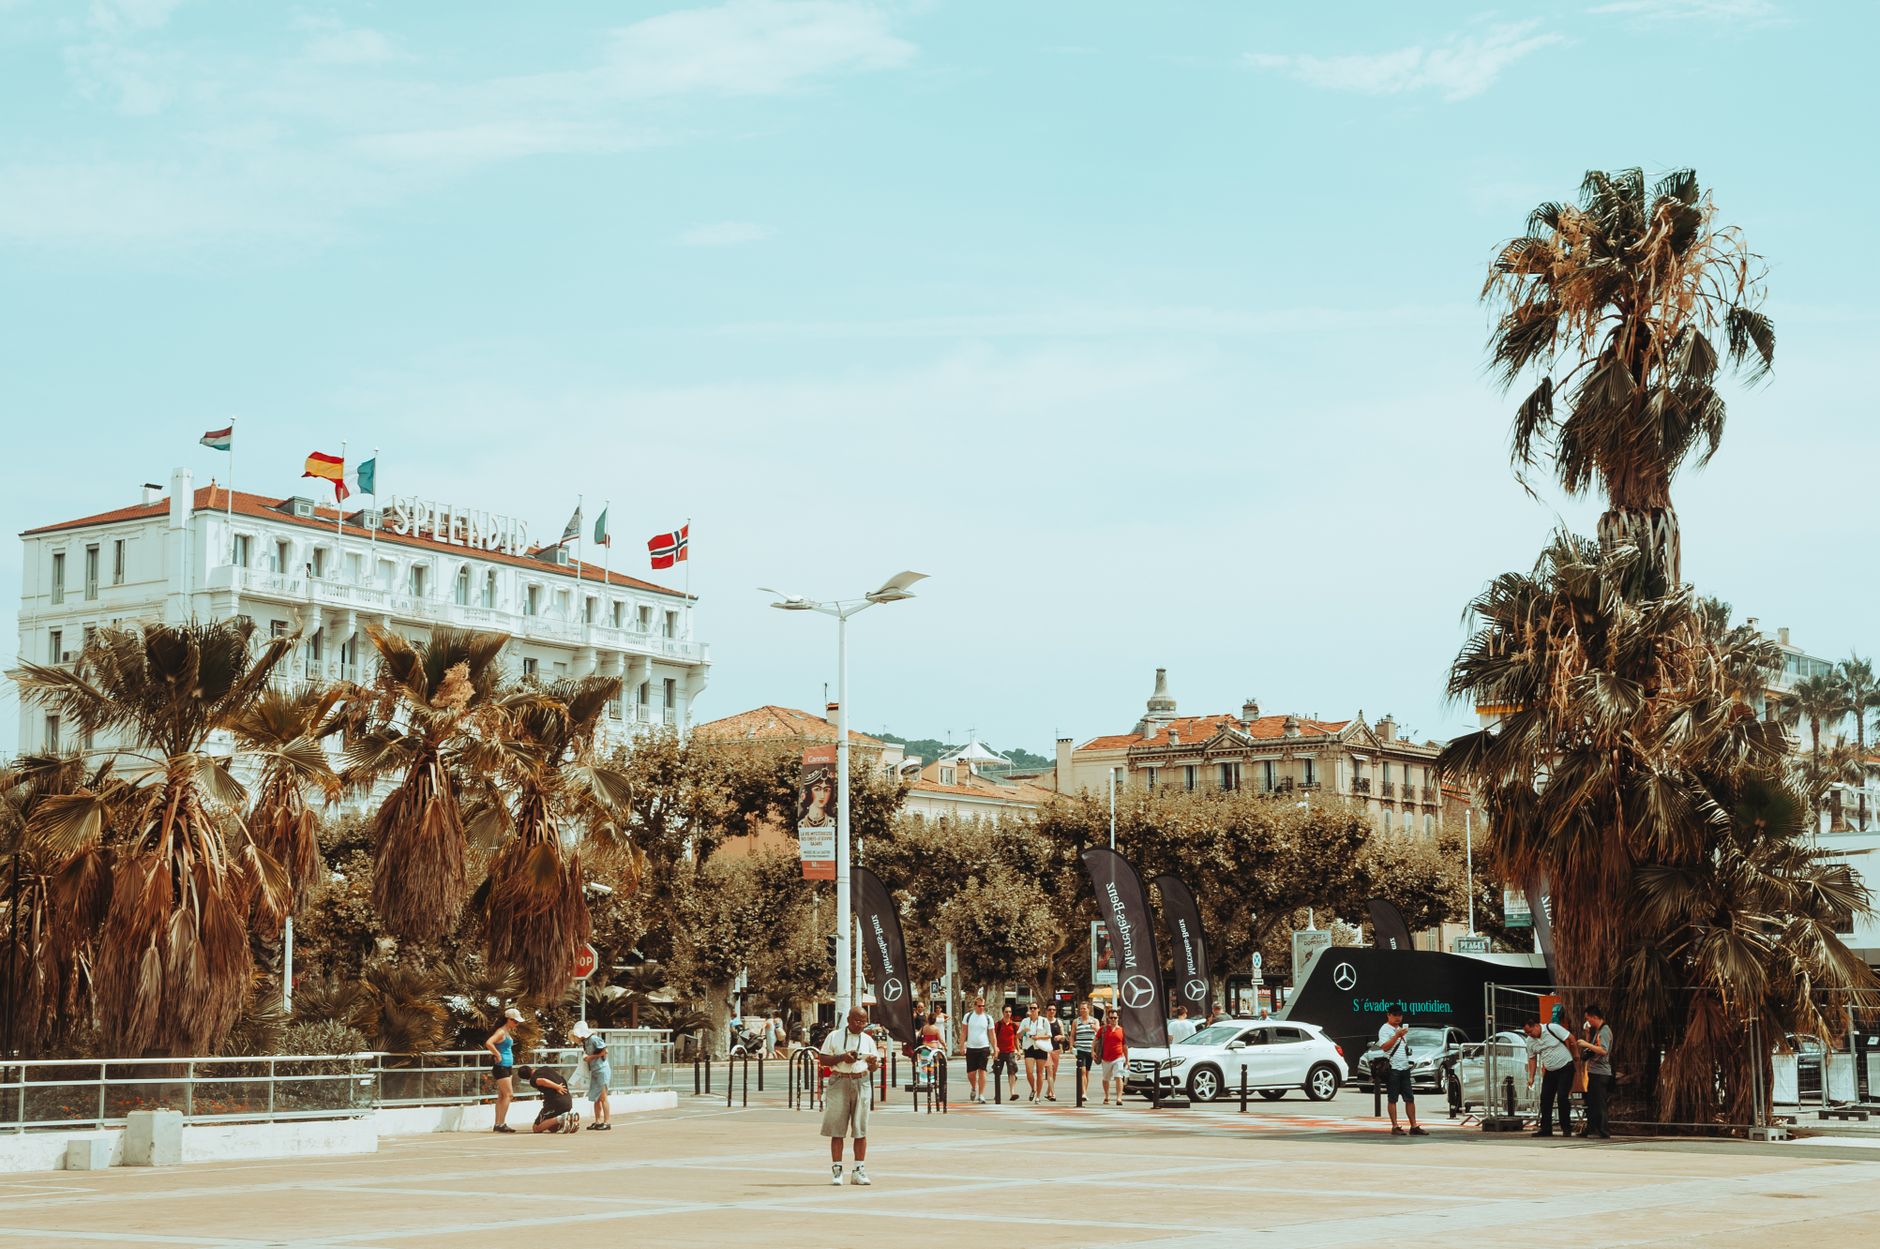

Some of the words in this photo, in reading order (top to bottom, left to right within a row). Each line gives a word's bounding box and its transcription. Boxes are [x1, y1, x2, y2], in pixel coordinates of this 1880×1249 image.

[392, 495, 529, 556] SPLENDID
[579, 956, 593, 967] OP
[1409, 999, 1454, 1015] quotidien.
